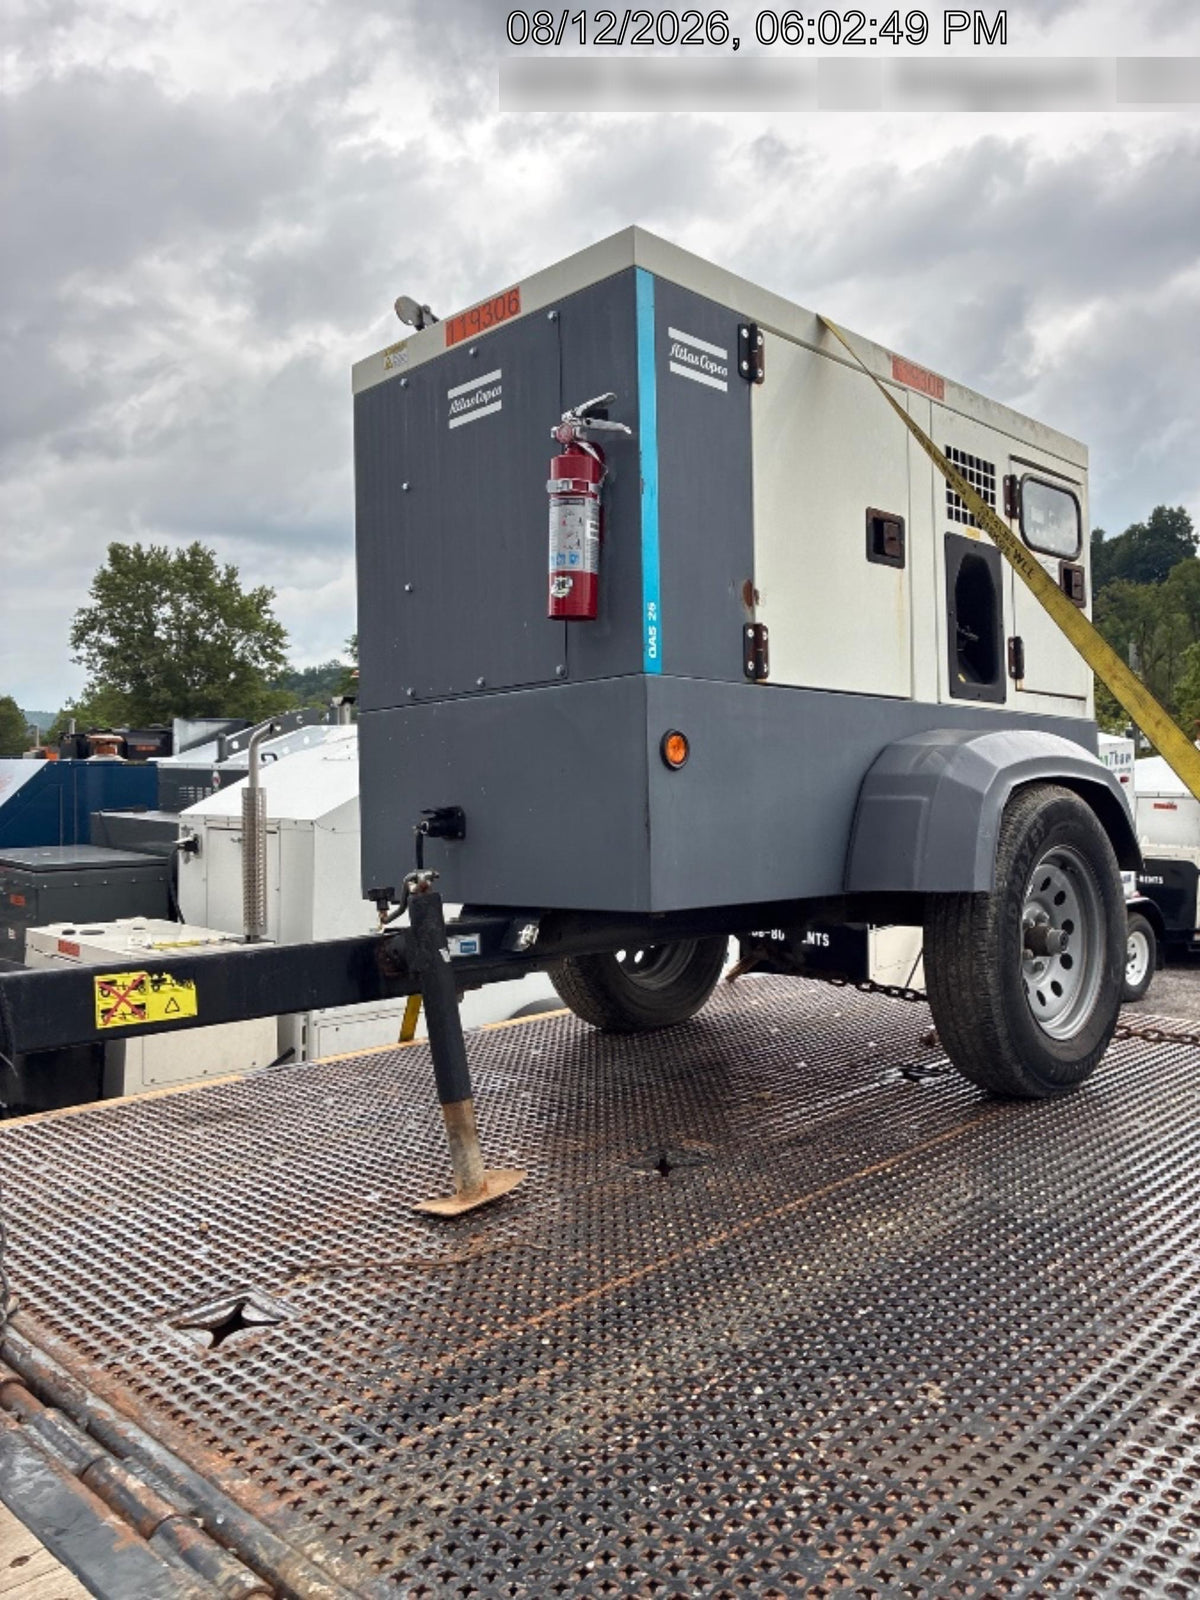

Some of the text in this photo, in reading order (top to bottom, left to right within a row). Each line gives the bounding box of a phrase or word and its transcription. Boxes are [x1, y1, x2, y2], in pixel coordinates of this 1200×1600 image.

[669, 342, 728, 377] Atlas Copco
[448, 385, 502, 417] Atlas Copco
